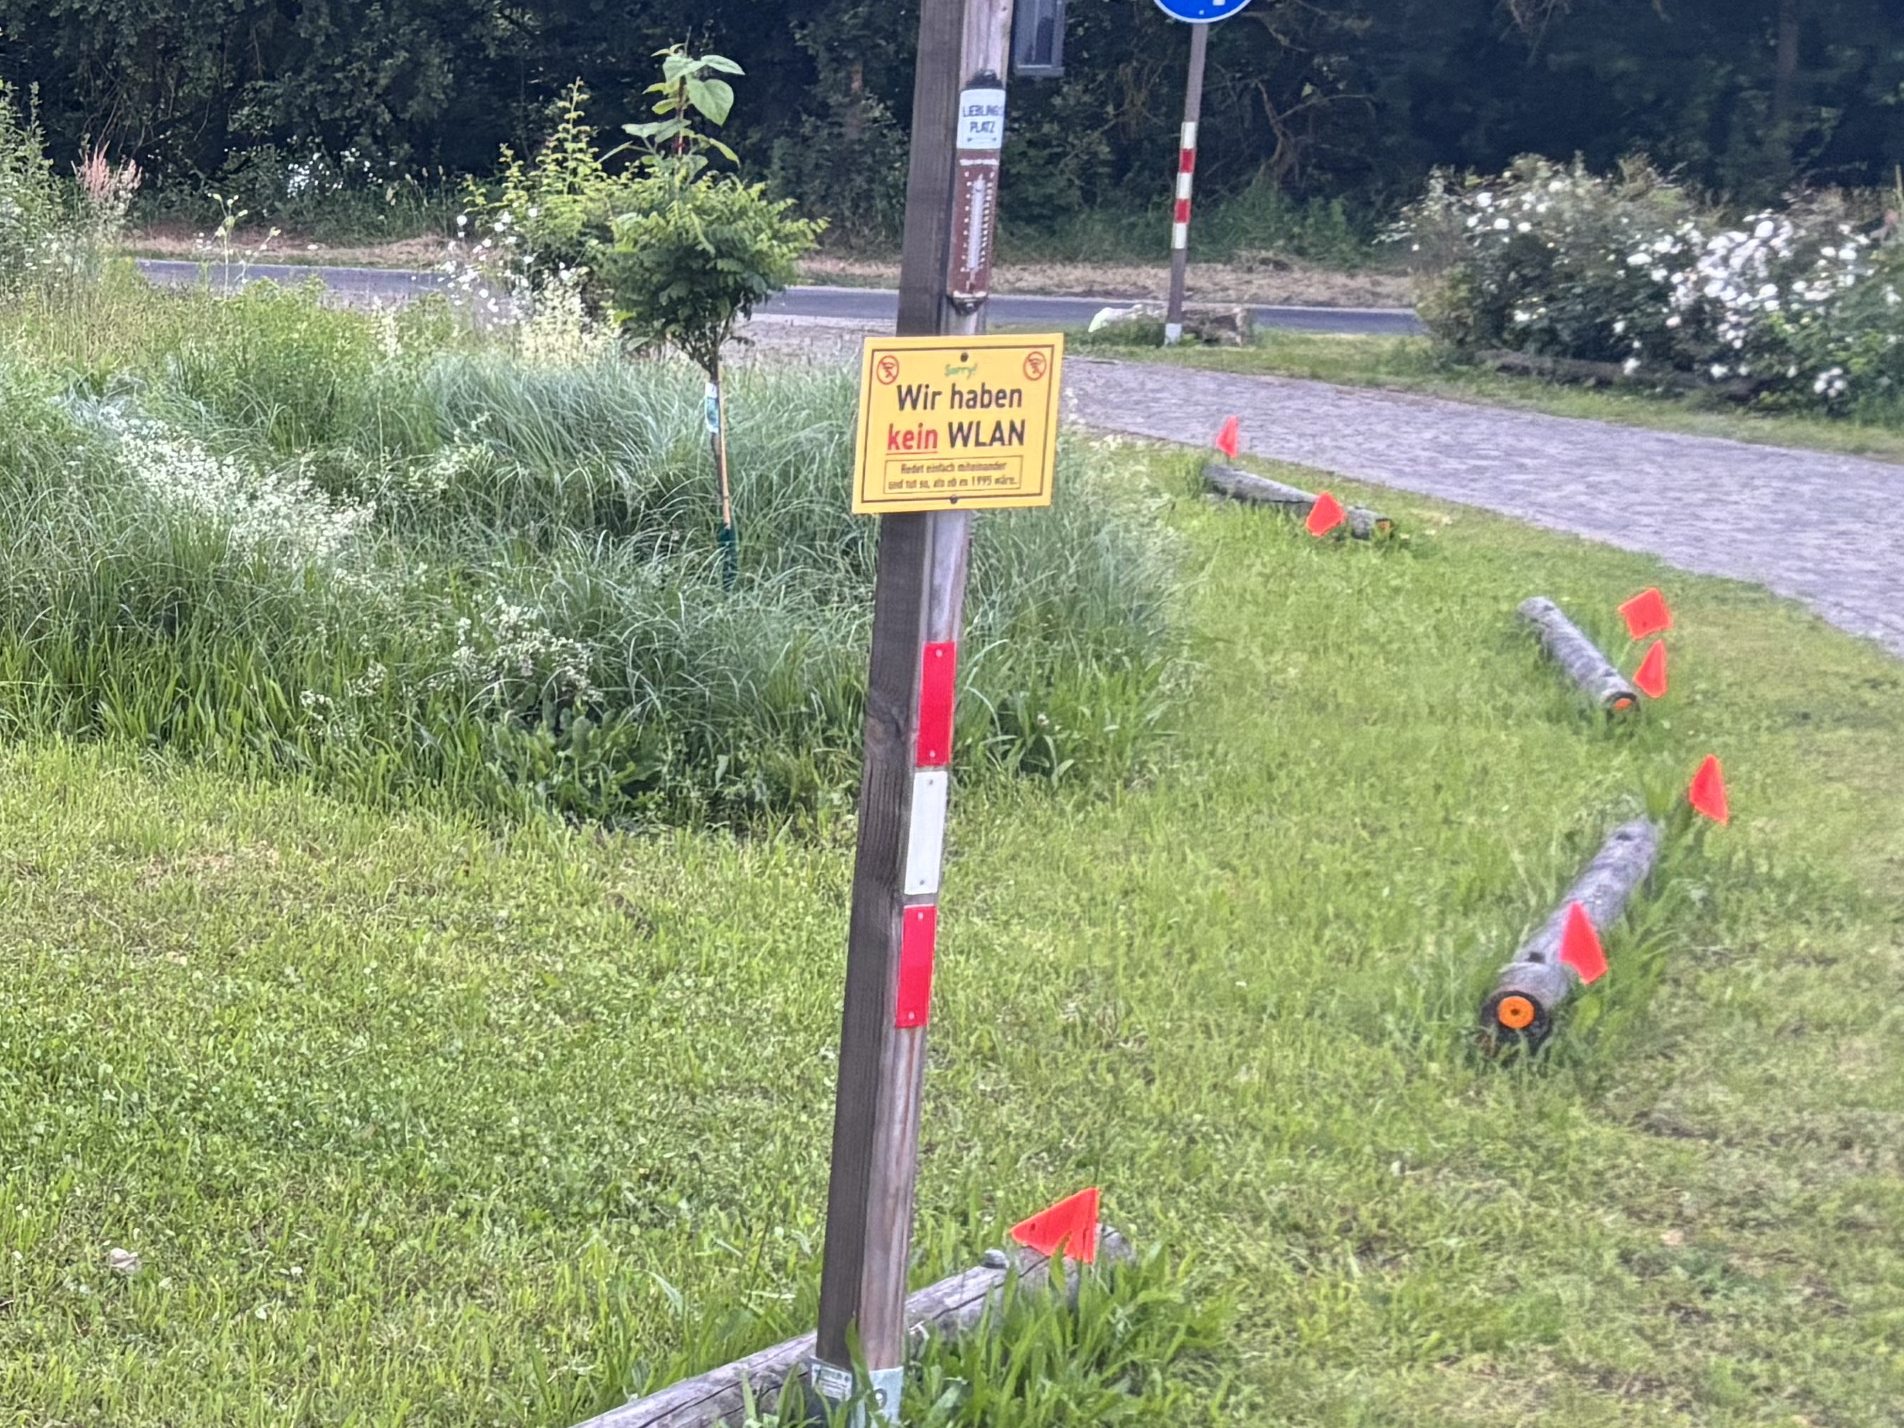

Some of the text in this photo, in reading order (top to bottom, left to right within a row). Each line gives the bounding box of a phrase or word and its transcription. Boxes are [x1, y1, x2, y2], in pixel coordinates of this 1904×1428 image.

[944, 362, 978, 380] Sorry!
[896, 381, 1022, 411] Wir haben
[886, 418, 1025, 451] kein WLAN
